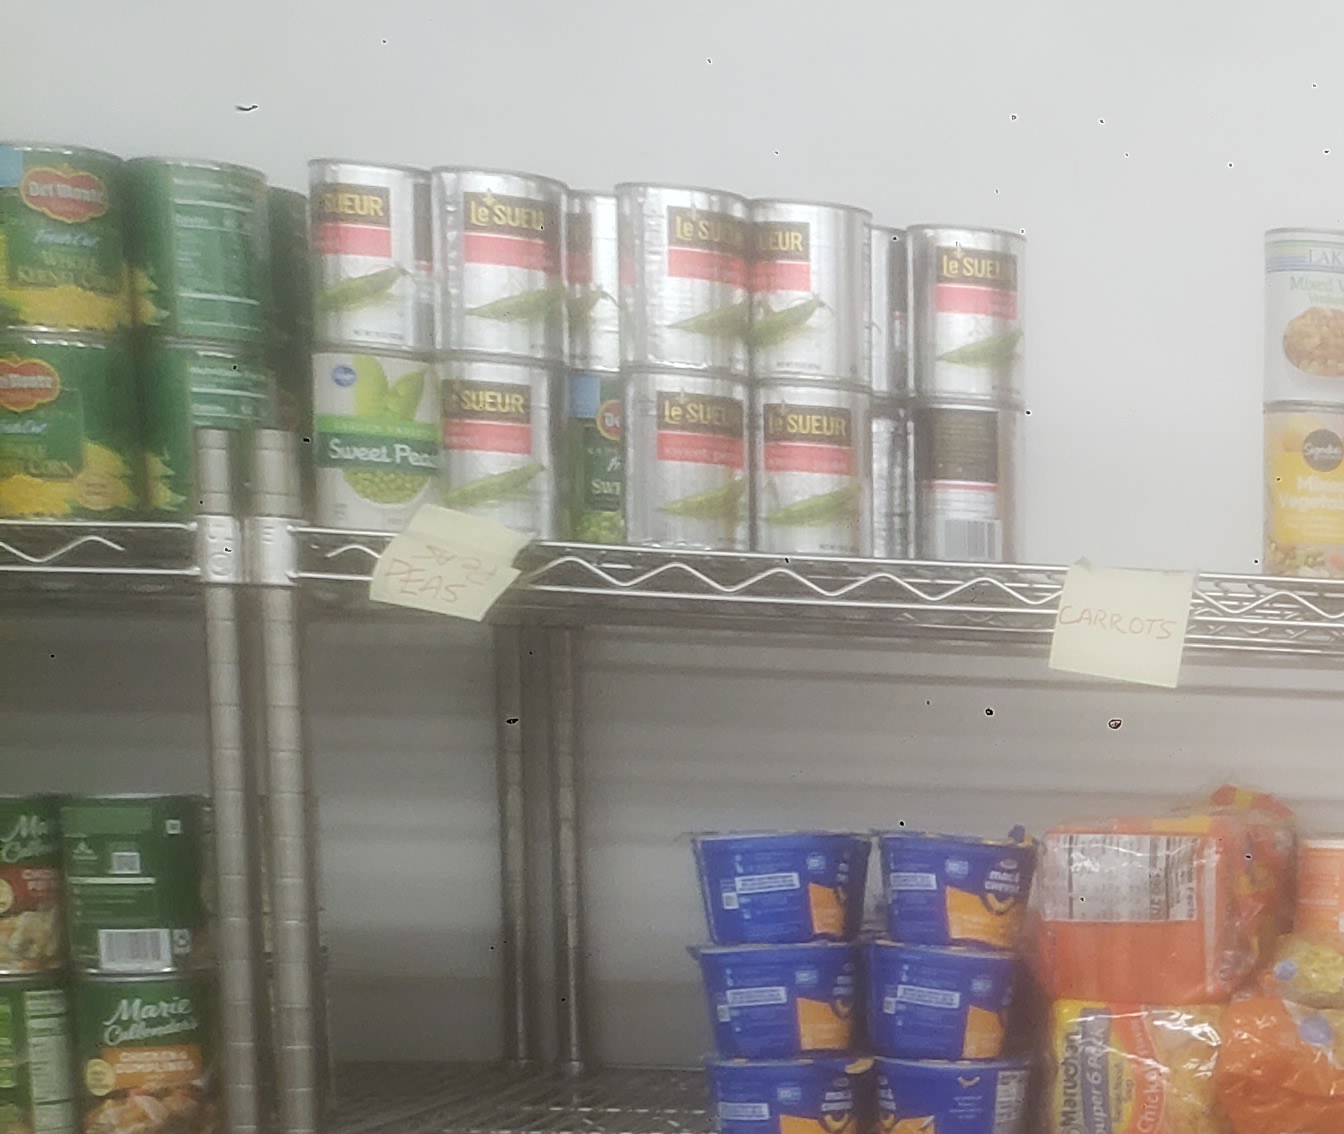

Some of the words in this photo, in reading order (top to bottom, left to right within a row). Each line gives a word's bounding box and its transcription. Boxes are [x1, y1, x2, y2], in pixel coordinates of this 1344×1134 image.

[492, 204, 545, 228] SUEU
[786, 412, 846, 438] SUEUR
[328, 439, 388, 462] Sweet
[1058, 605, 1177, 640] CARROTS
[103, 996, 193, 1026] Marie
[1060, 1026, 1084, 1127] Maruchan
